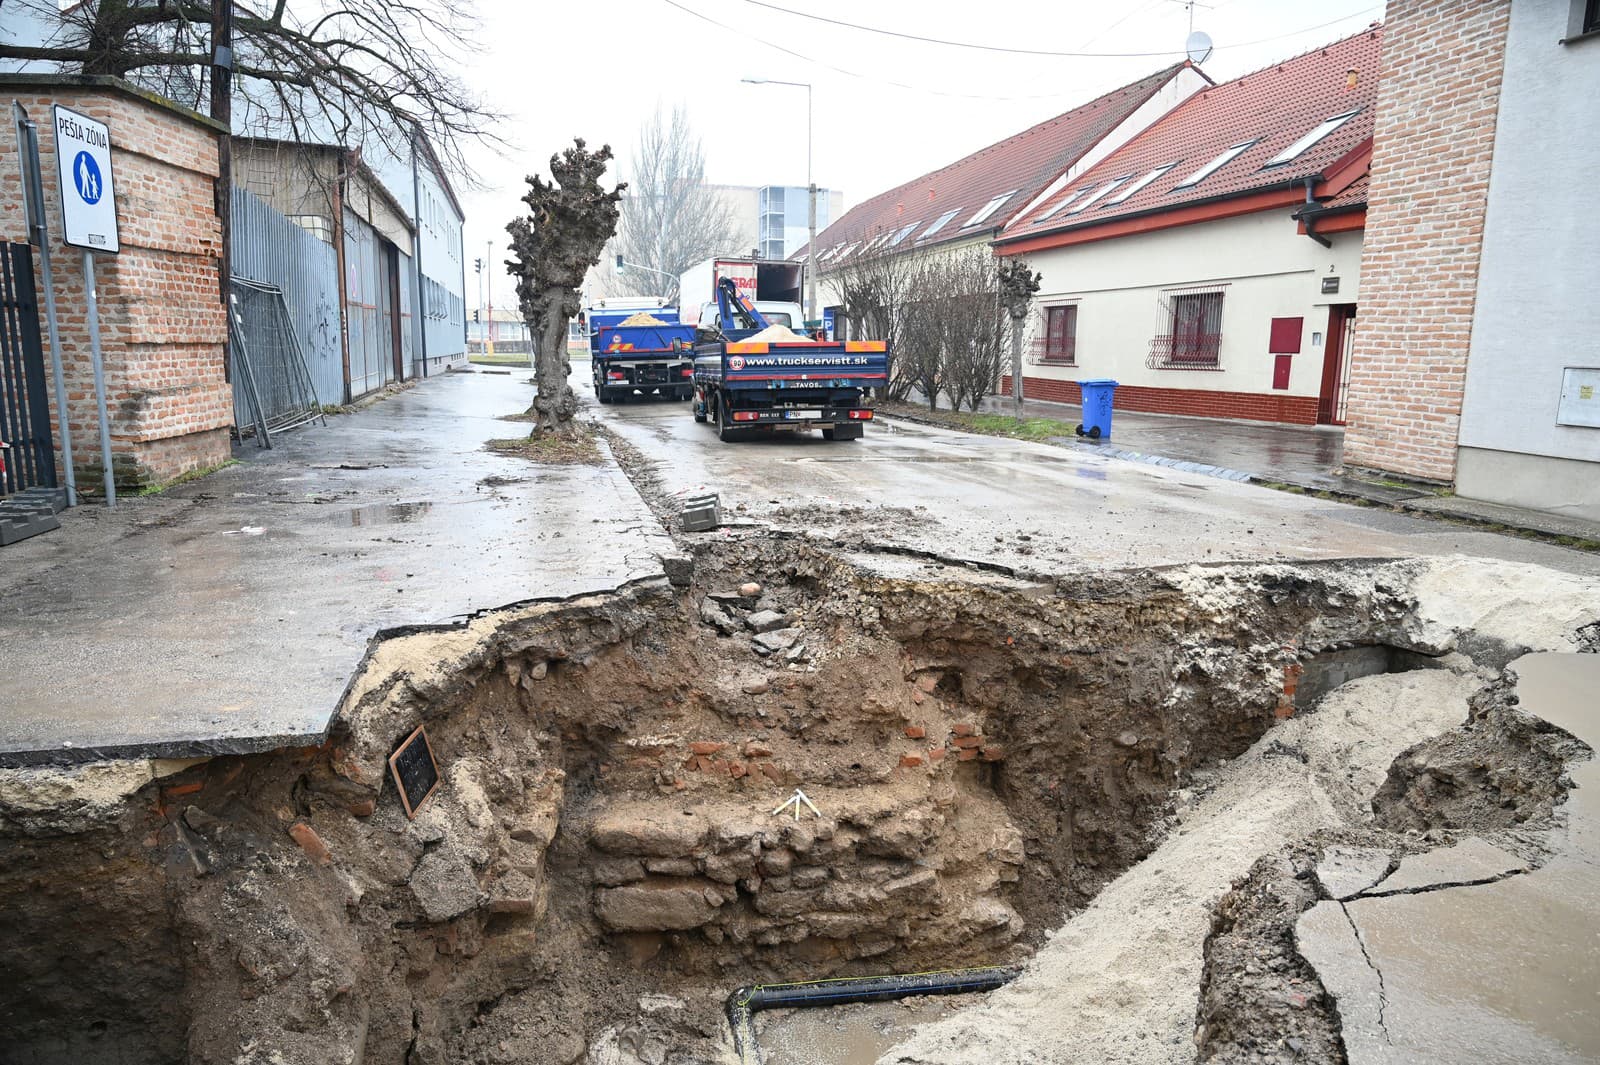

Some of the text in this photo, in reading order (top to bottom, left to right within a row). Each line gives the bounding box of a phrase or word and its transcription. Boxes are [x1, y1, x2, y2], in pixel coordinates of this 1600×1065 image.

[58, 116, 108, 150] PEŠIA ZÓNA
[1329, 264, 1335, 273] 2
[825, 320, 833, 330] P
[746, 356, 868, 365] www.truckservistt.sk
